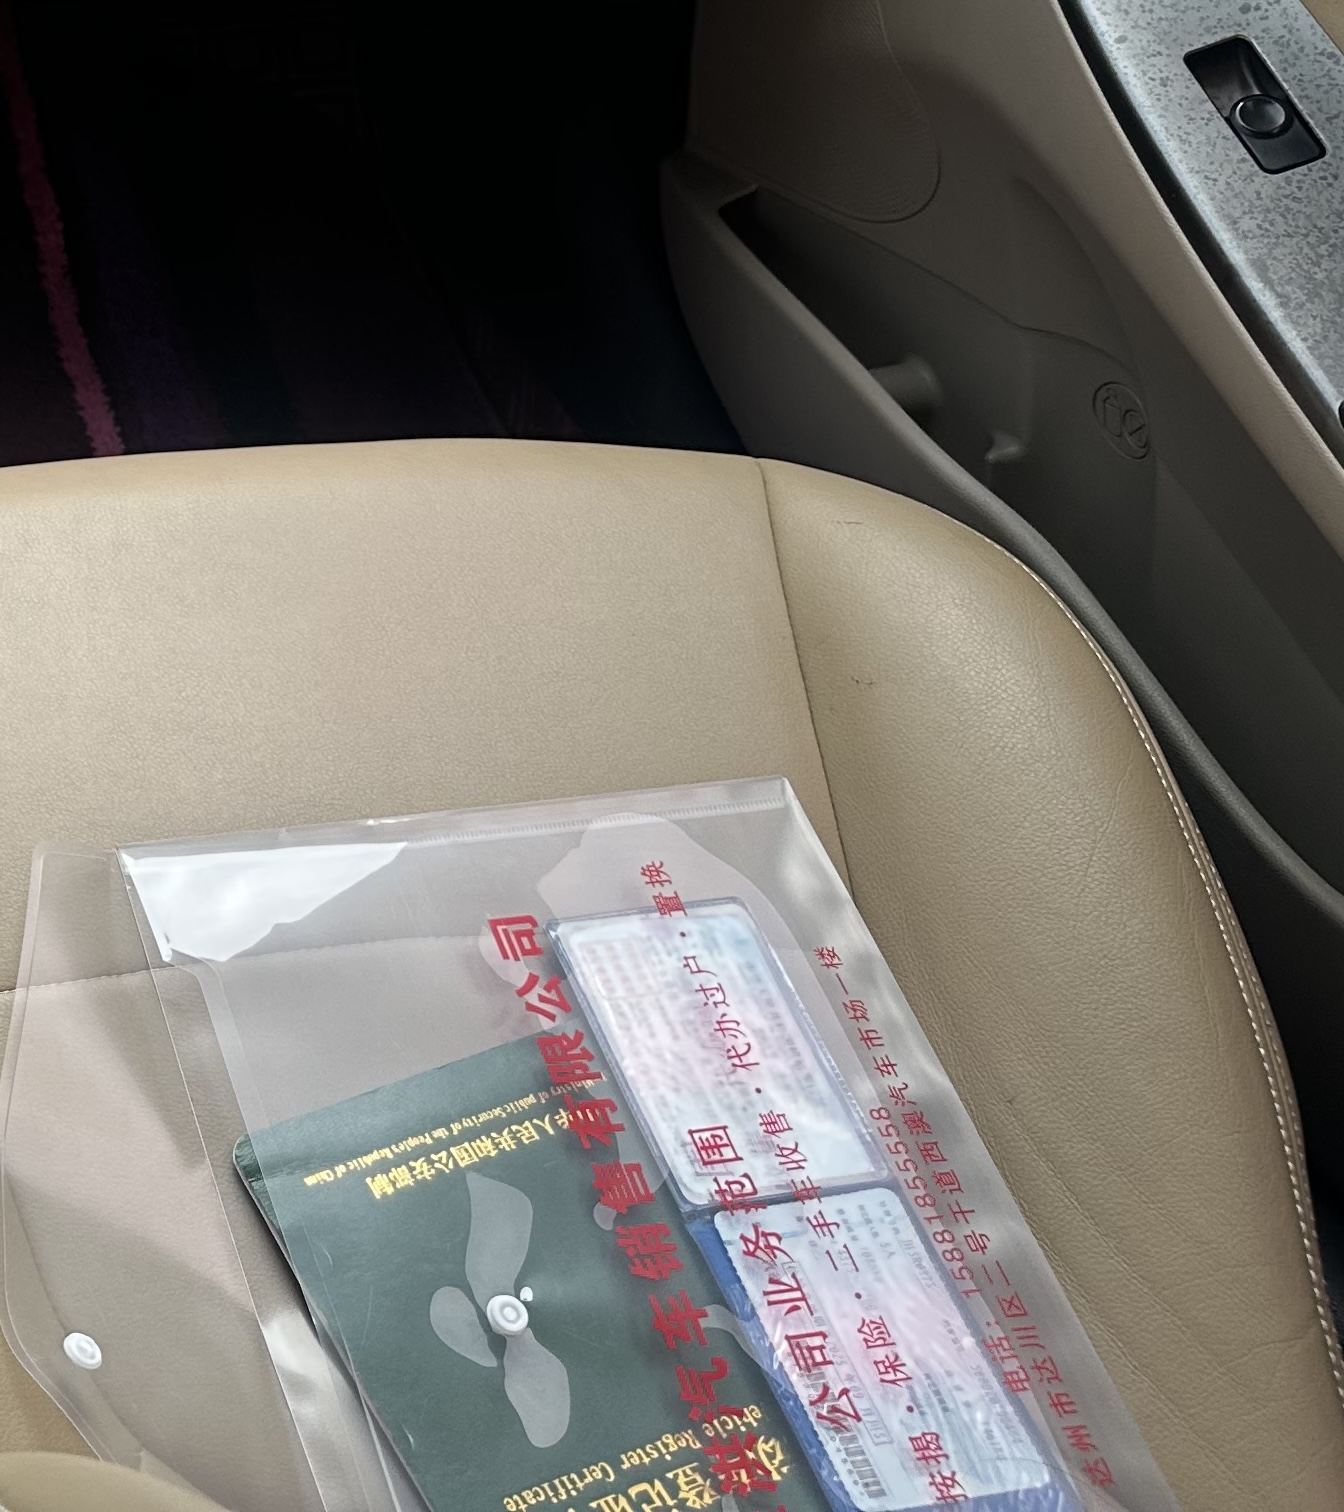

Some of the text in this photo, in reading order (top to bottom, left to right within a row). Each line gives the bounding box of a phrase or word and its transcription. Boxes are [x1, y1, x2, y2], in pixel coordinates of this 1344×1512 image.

[486, 913, 789, 1512] 洪汽车销售有限公司
[687, 1124, 864, 1432] 公司业务范围
[502, 1403, 765, 1512] ehicle Register Certificate
